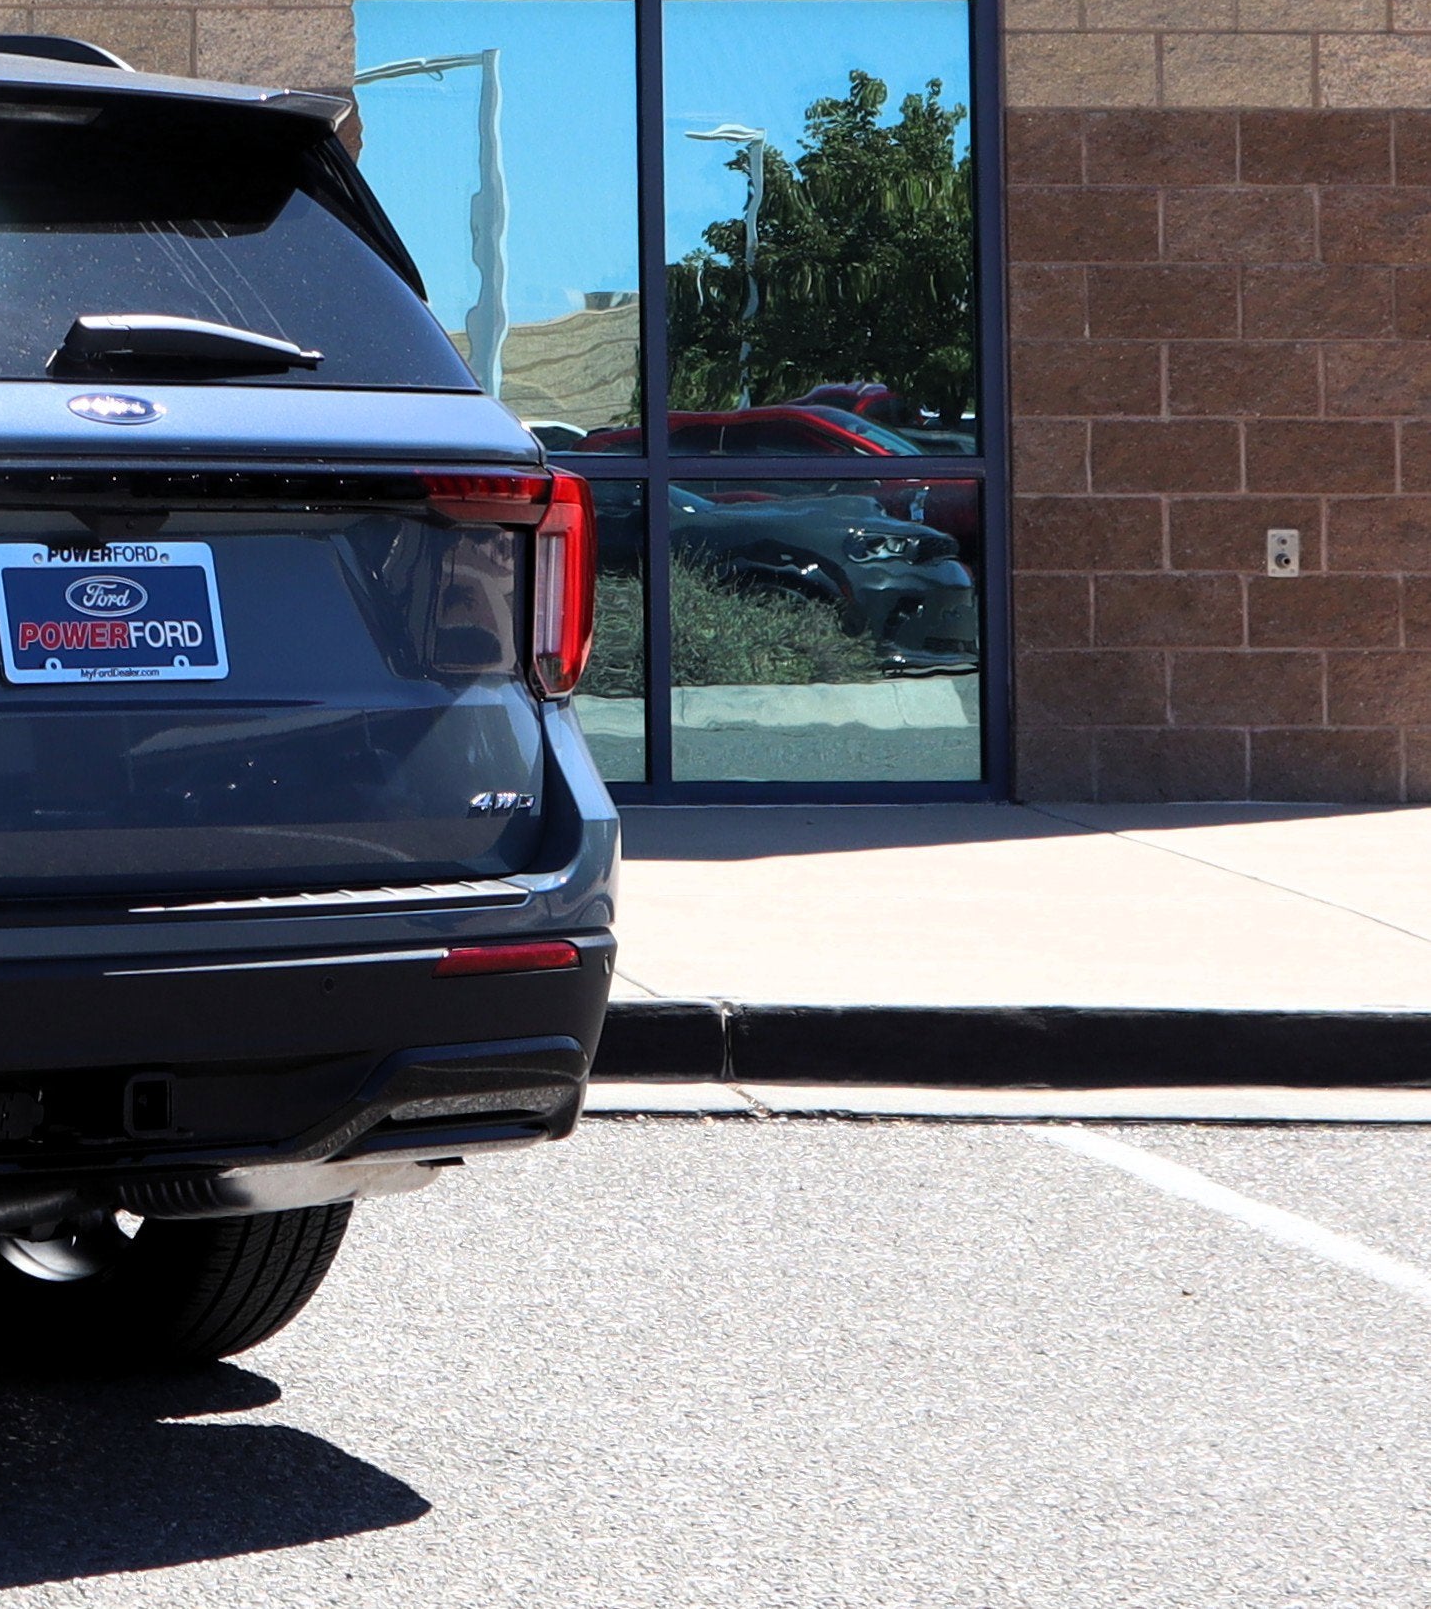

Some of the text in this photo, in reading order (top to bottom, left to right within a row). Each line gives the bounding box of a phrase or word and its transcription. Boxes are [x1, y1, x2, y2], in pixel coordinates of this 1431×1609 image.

[83, 583, 130, 607] Ford
[19, 621, 202, 650] POWERFORD
[470, 792, 535, 810] 4WD
